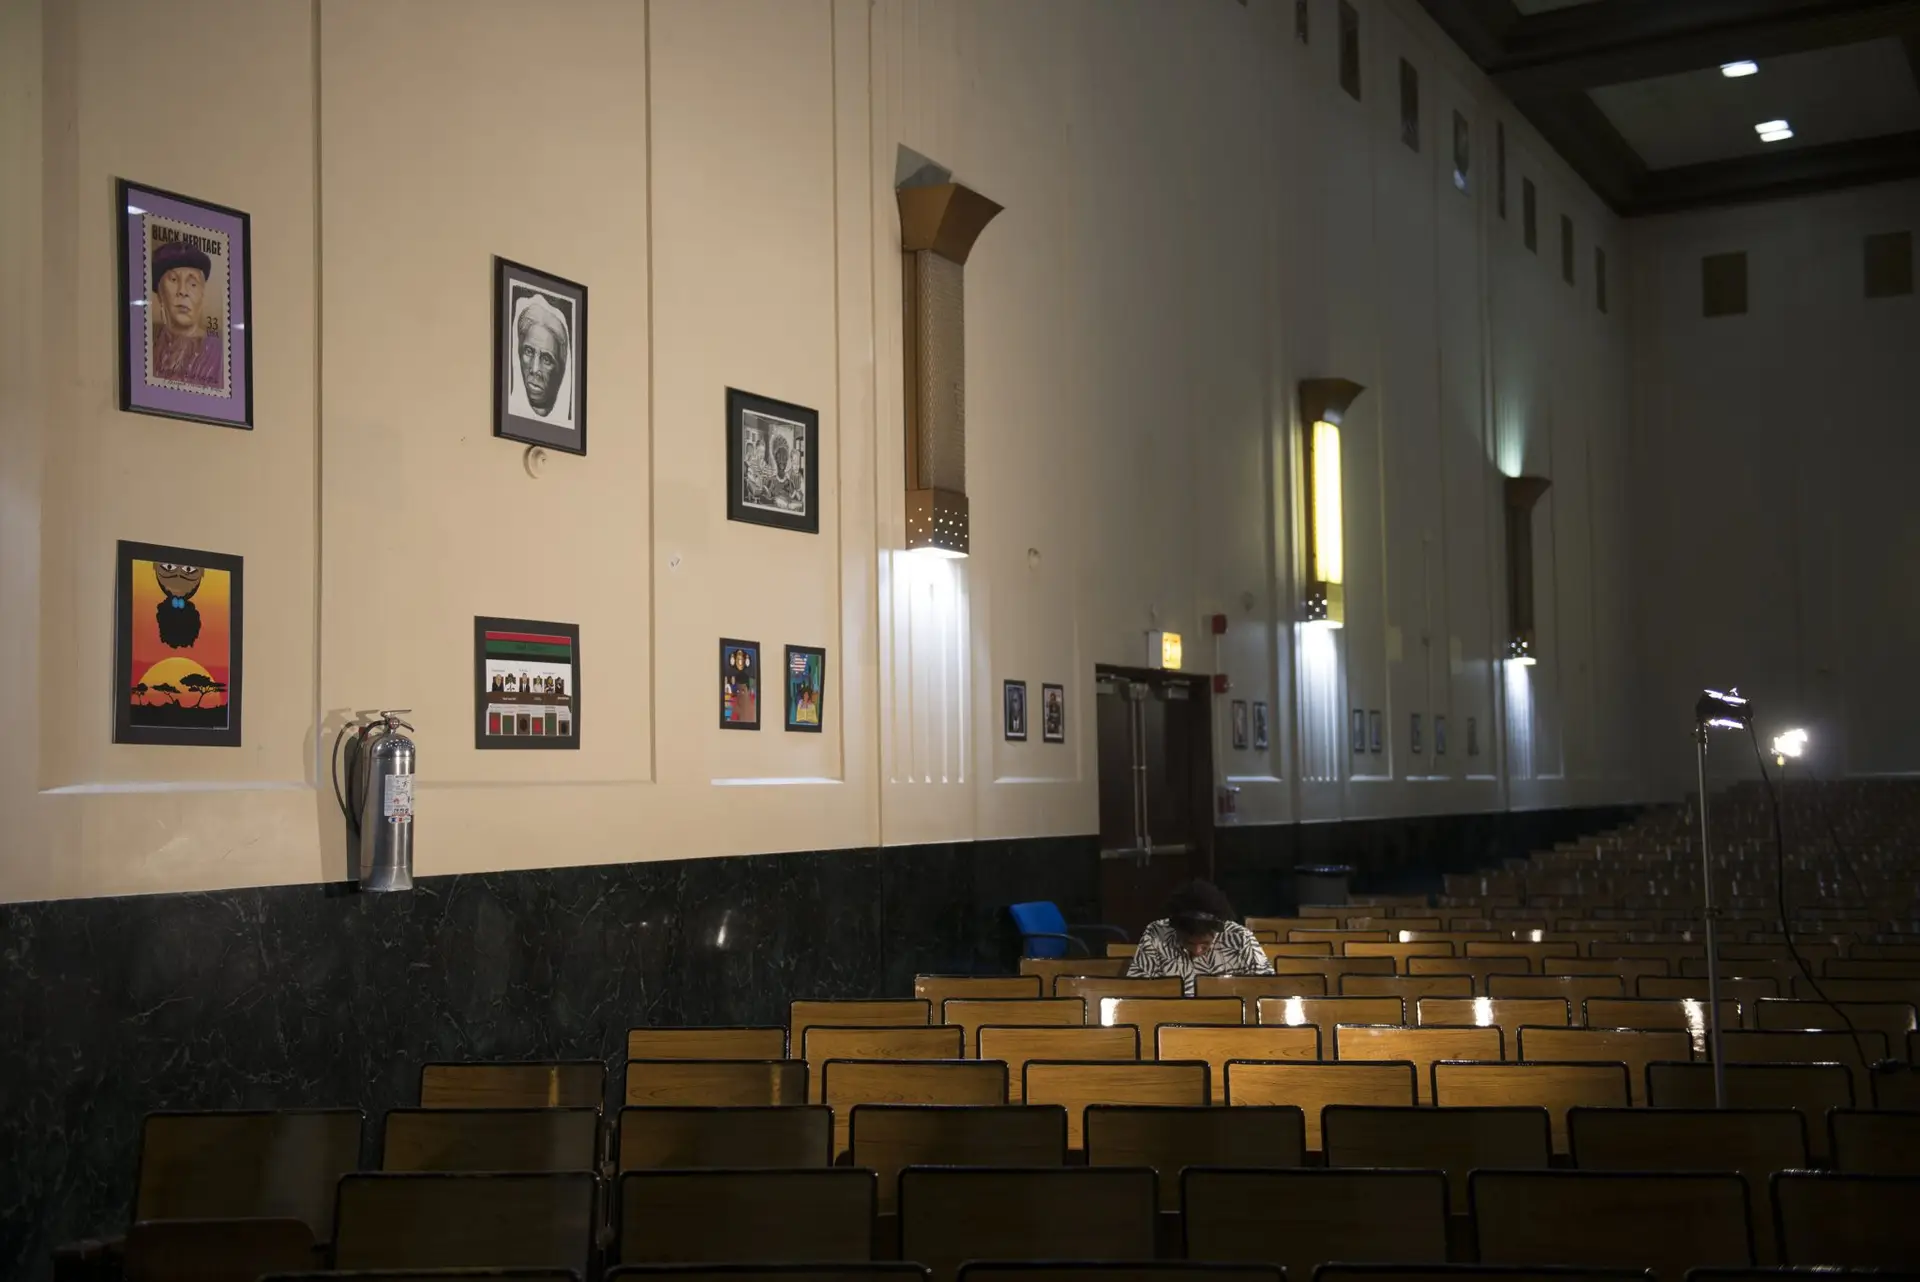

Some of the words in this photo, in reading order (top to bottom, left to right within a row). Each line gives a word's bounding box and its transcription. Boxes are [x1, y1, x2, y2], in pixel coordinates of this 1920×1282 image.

[152, 224, 180, 242] BLACK
[183, 232, 222, 256] HERITAGE
[207, 316, 218, 330] 33
